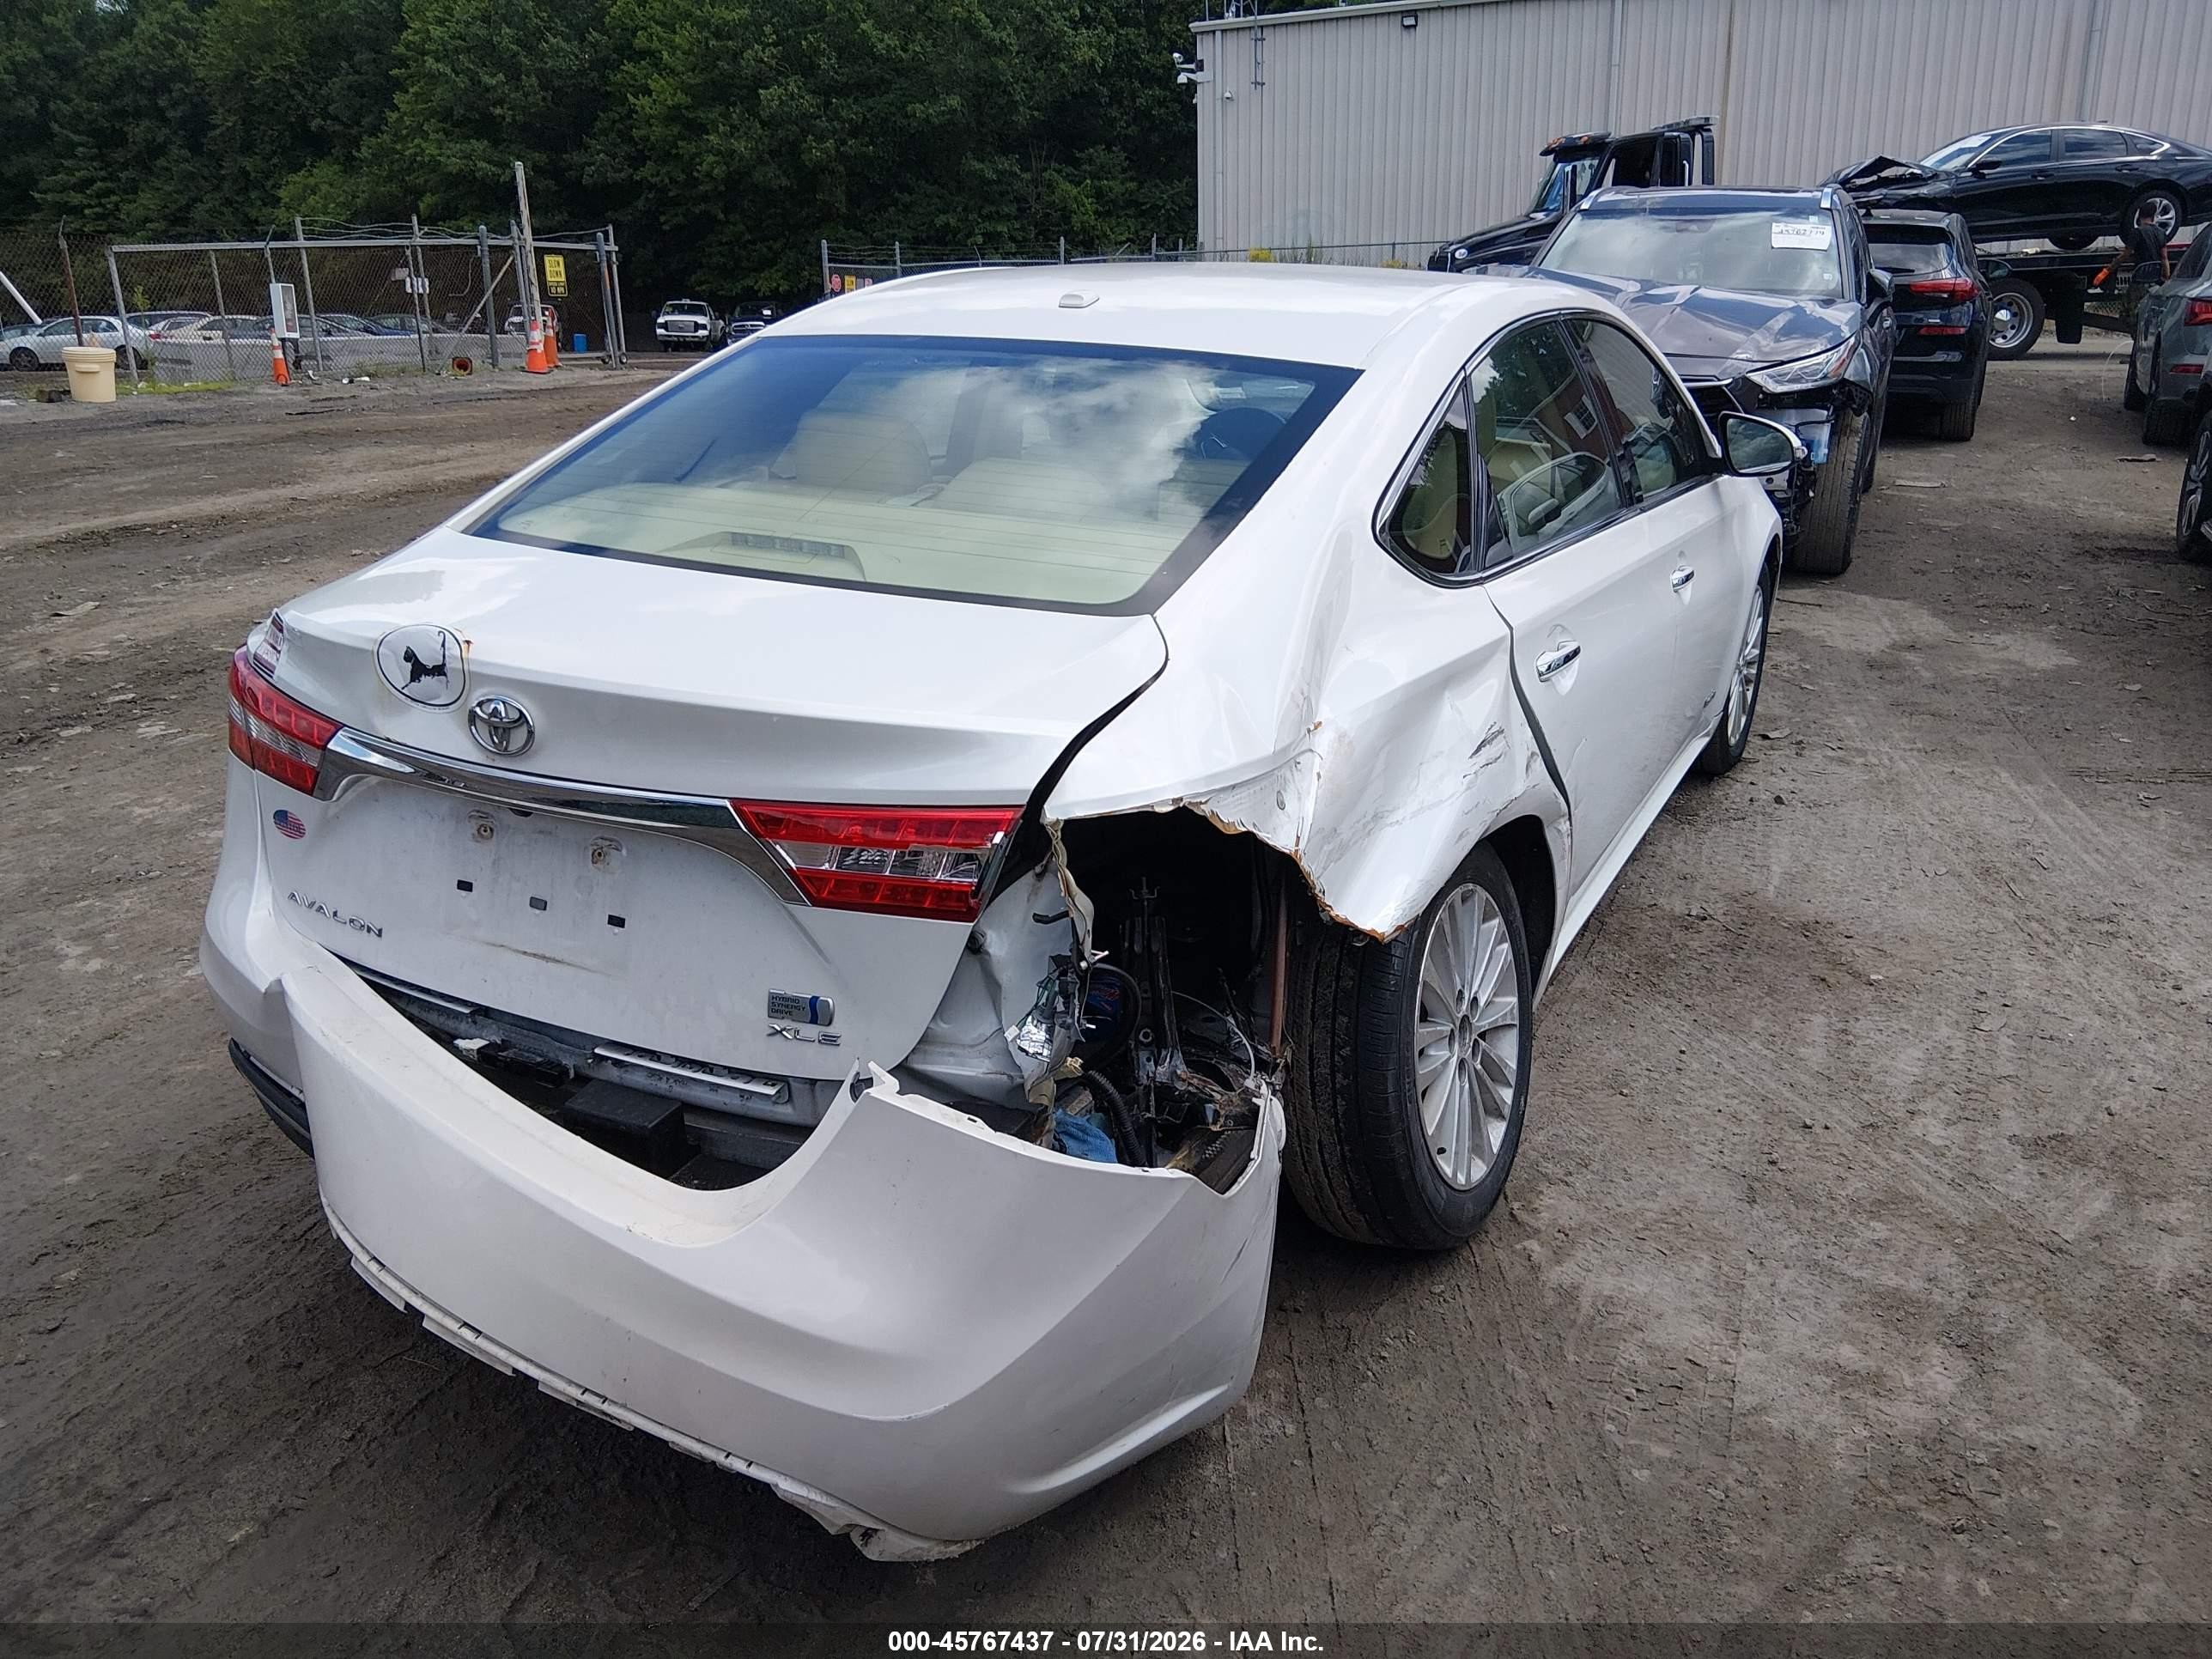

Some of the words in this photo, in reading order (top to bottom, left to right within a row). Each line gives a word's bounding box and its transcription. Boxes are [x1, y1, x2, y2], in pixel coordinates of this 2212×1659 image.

[548, 259, 561, 268] SLOW
[549, 270, 562, 278] DOWN
[288, 890, 383, 938] AVALON
[771, 995, 800, 1004] HYBRID
[771, 1001, 805, 1012] SYNERGY
[770, 1007, 793, 1017] DRIVE
[767, 1024, 842, 1047] XLE
